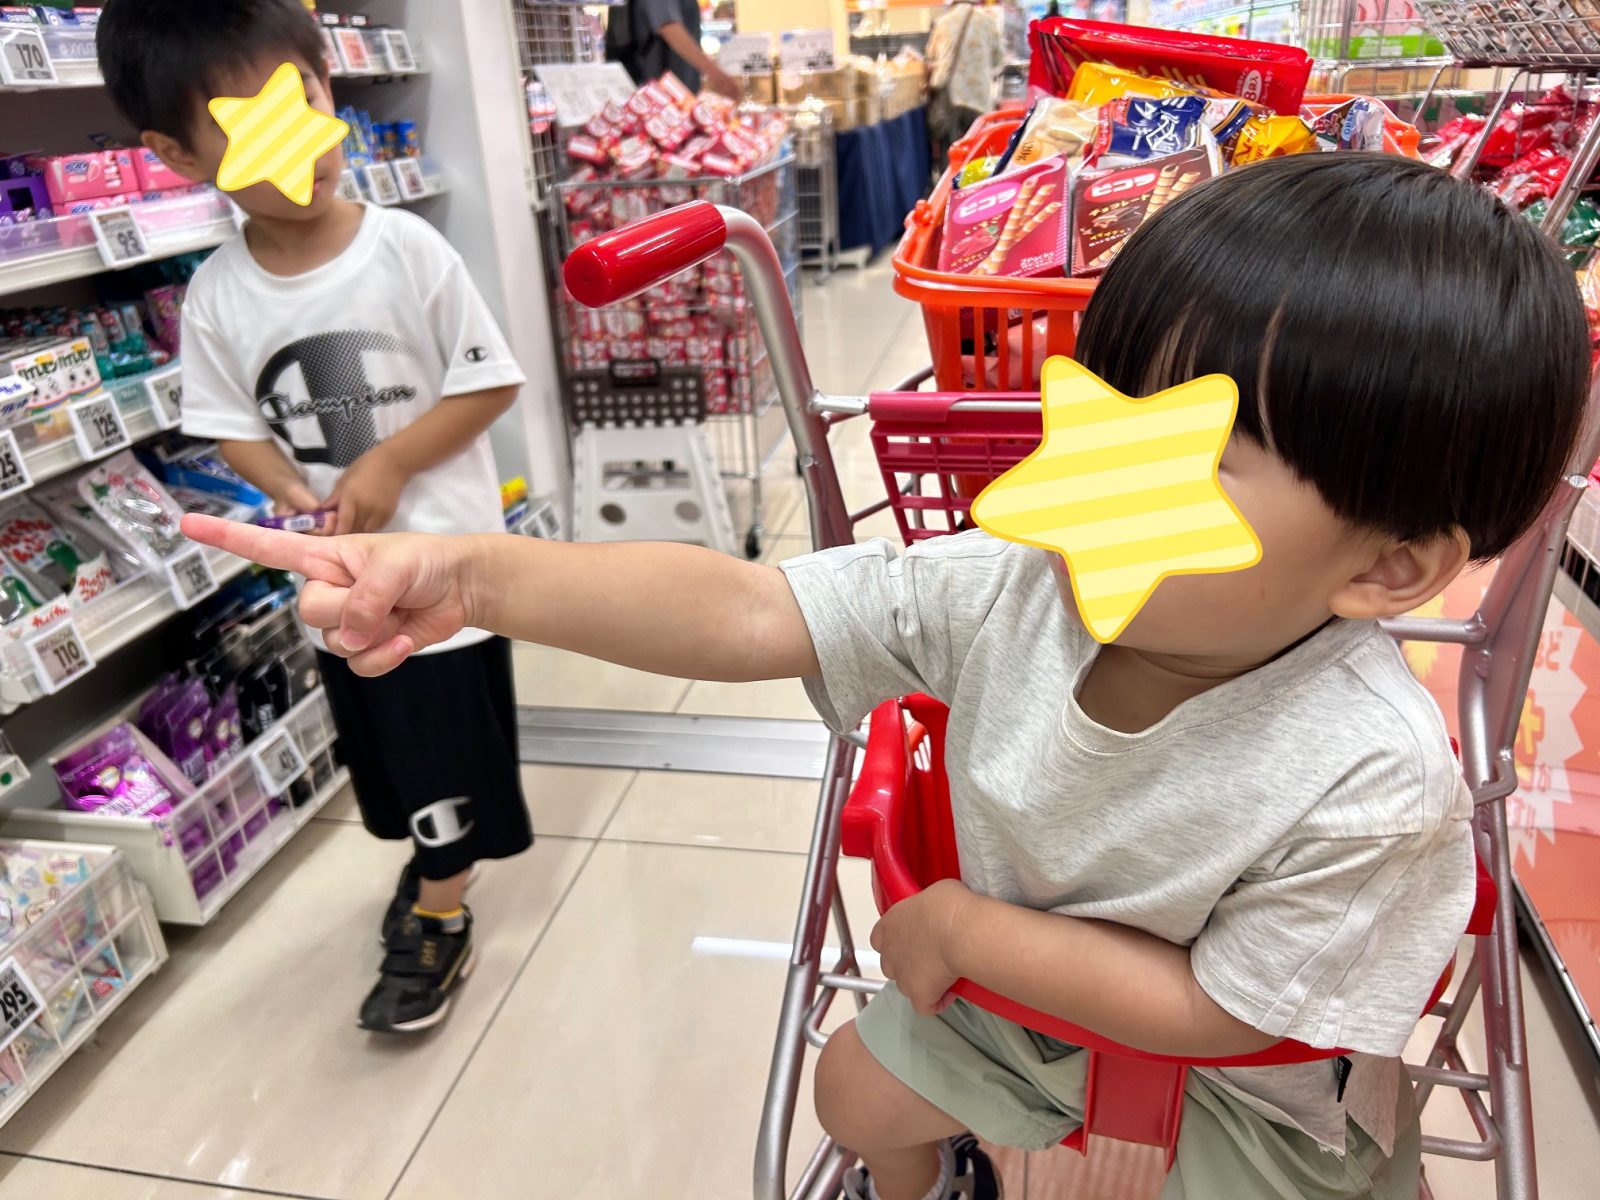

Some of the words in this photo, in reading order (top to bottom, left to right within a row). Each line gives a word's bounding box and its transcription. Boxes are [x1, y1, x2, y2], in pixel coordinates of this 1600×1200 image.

[15, 43, 44, 68] 170
[117, 230, 140, 254] 95
[258, 384, 417, 424] Champion
[92, 412, 118, 440] 125
[53, 641, 80, 668] 110
